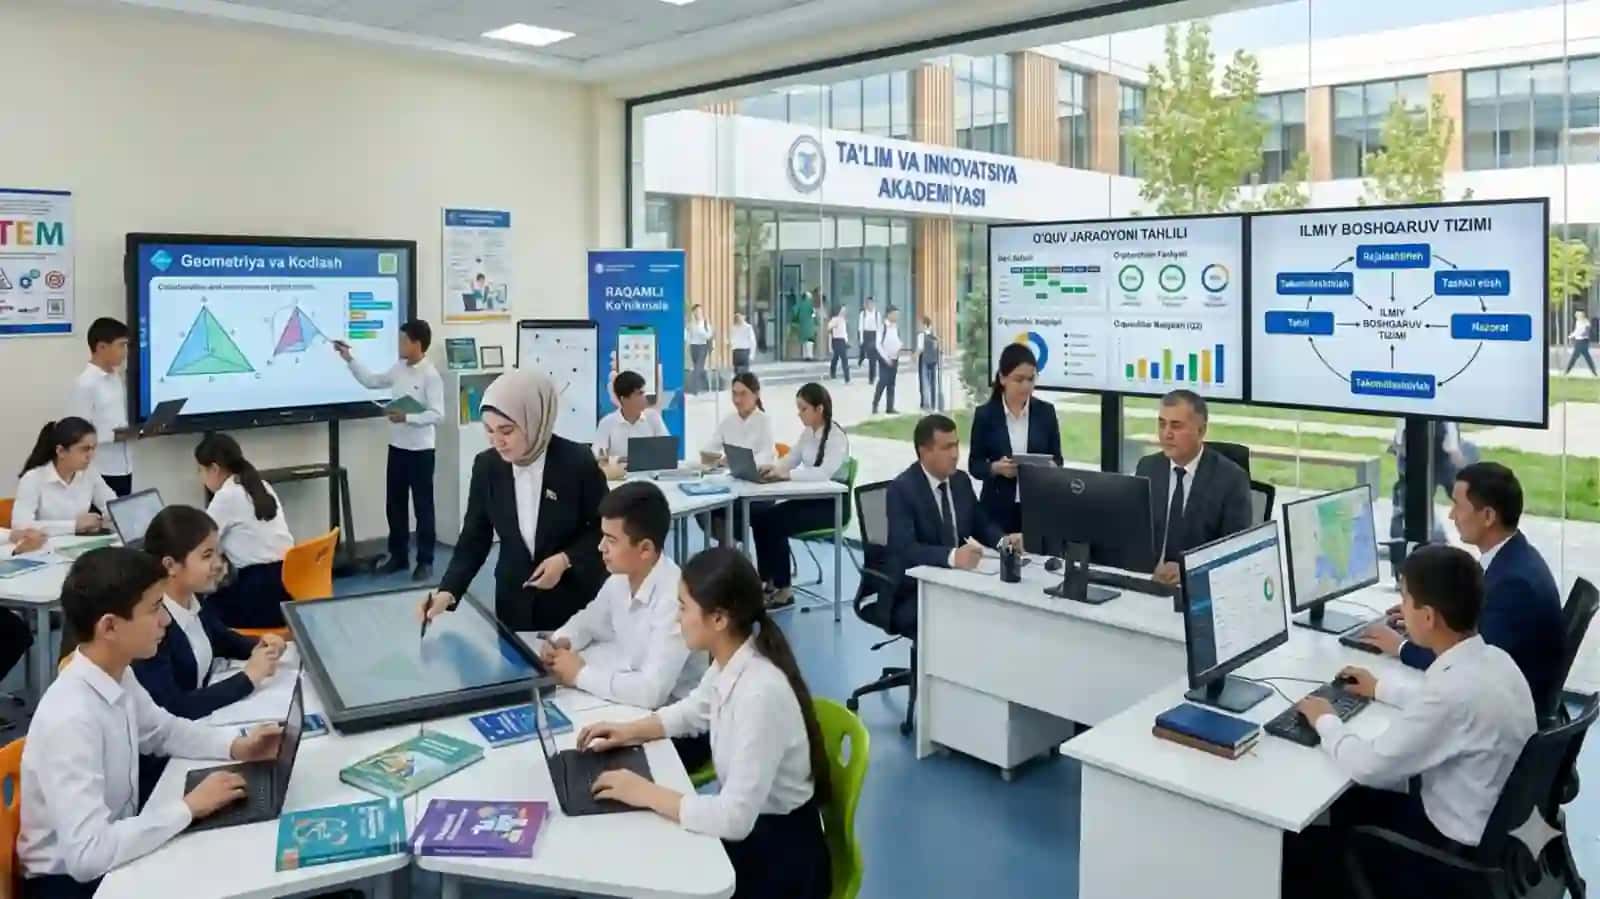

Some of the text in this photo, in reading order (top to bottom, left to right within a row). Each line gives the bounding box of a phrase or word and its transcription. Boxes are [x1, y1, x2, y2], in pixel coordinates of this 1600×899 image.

[836, 141, 1017, 184] TA'LIM VA INNOVATSIYA
[878, 177, 986, 207] AKADEMIYASI
[1140, 226, 1188, 240] TAHLILI
[1300, 217, 1492, 237] ILMIY BOSHQARUV TIZIMI
[181, 254, 342, 271] Geometriya va Kodlash
[605, 286, 664, 299] RAQAMLI
[1380, 308, 1406, 317] ILMIY
